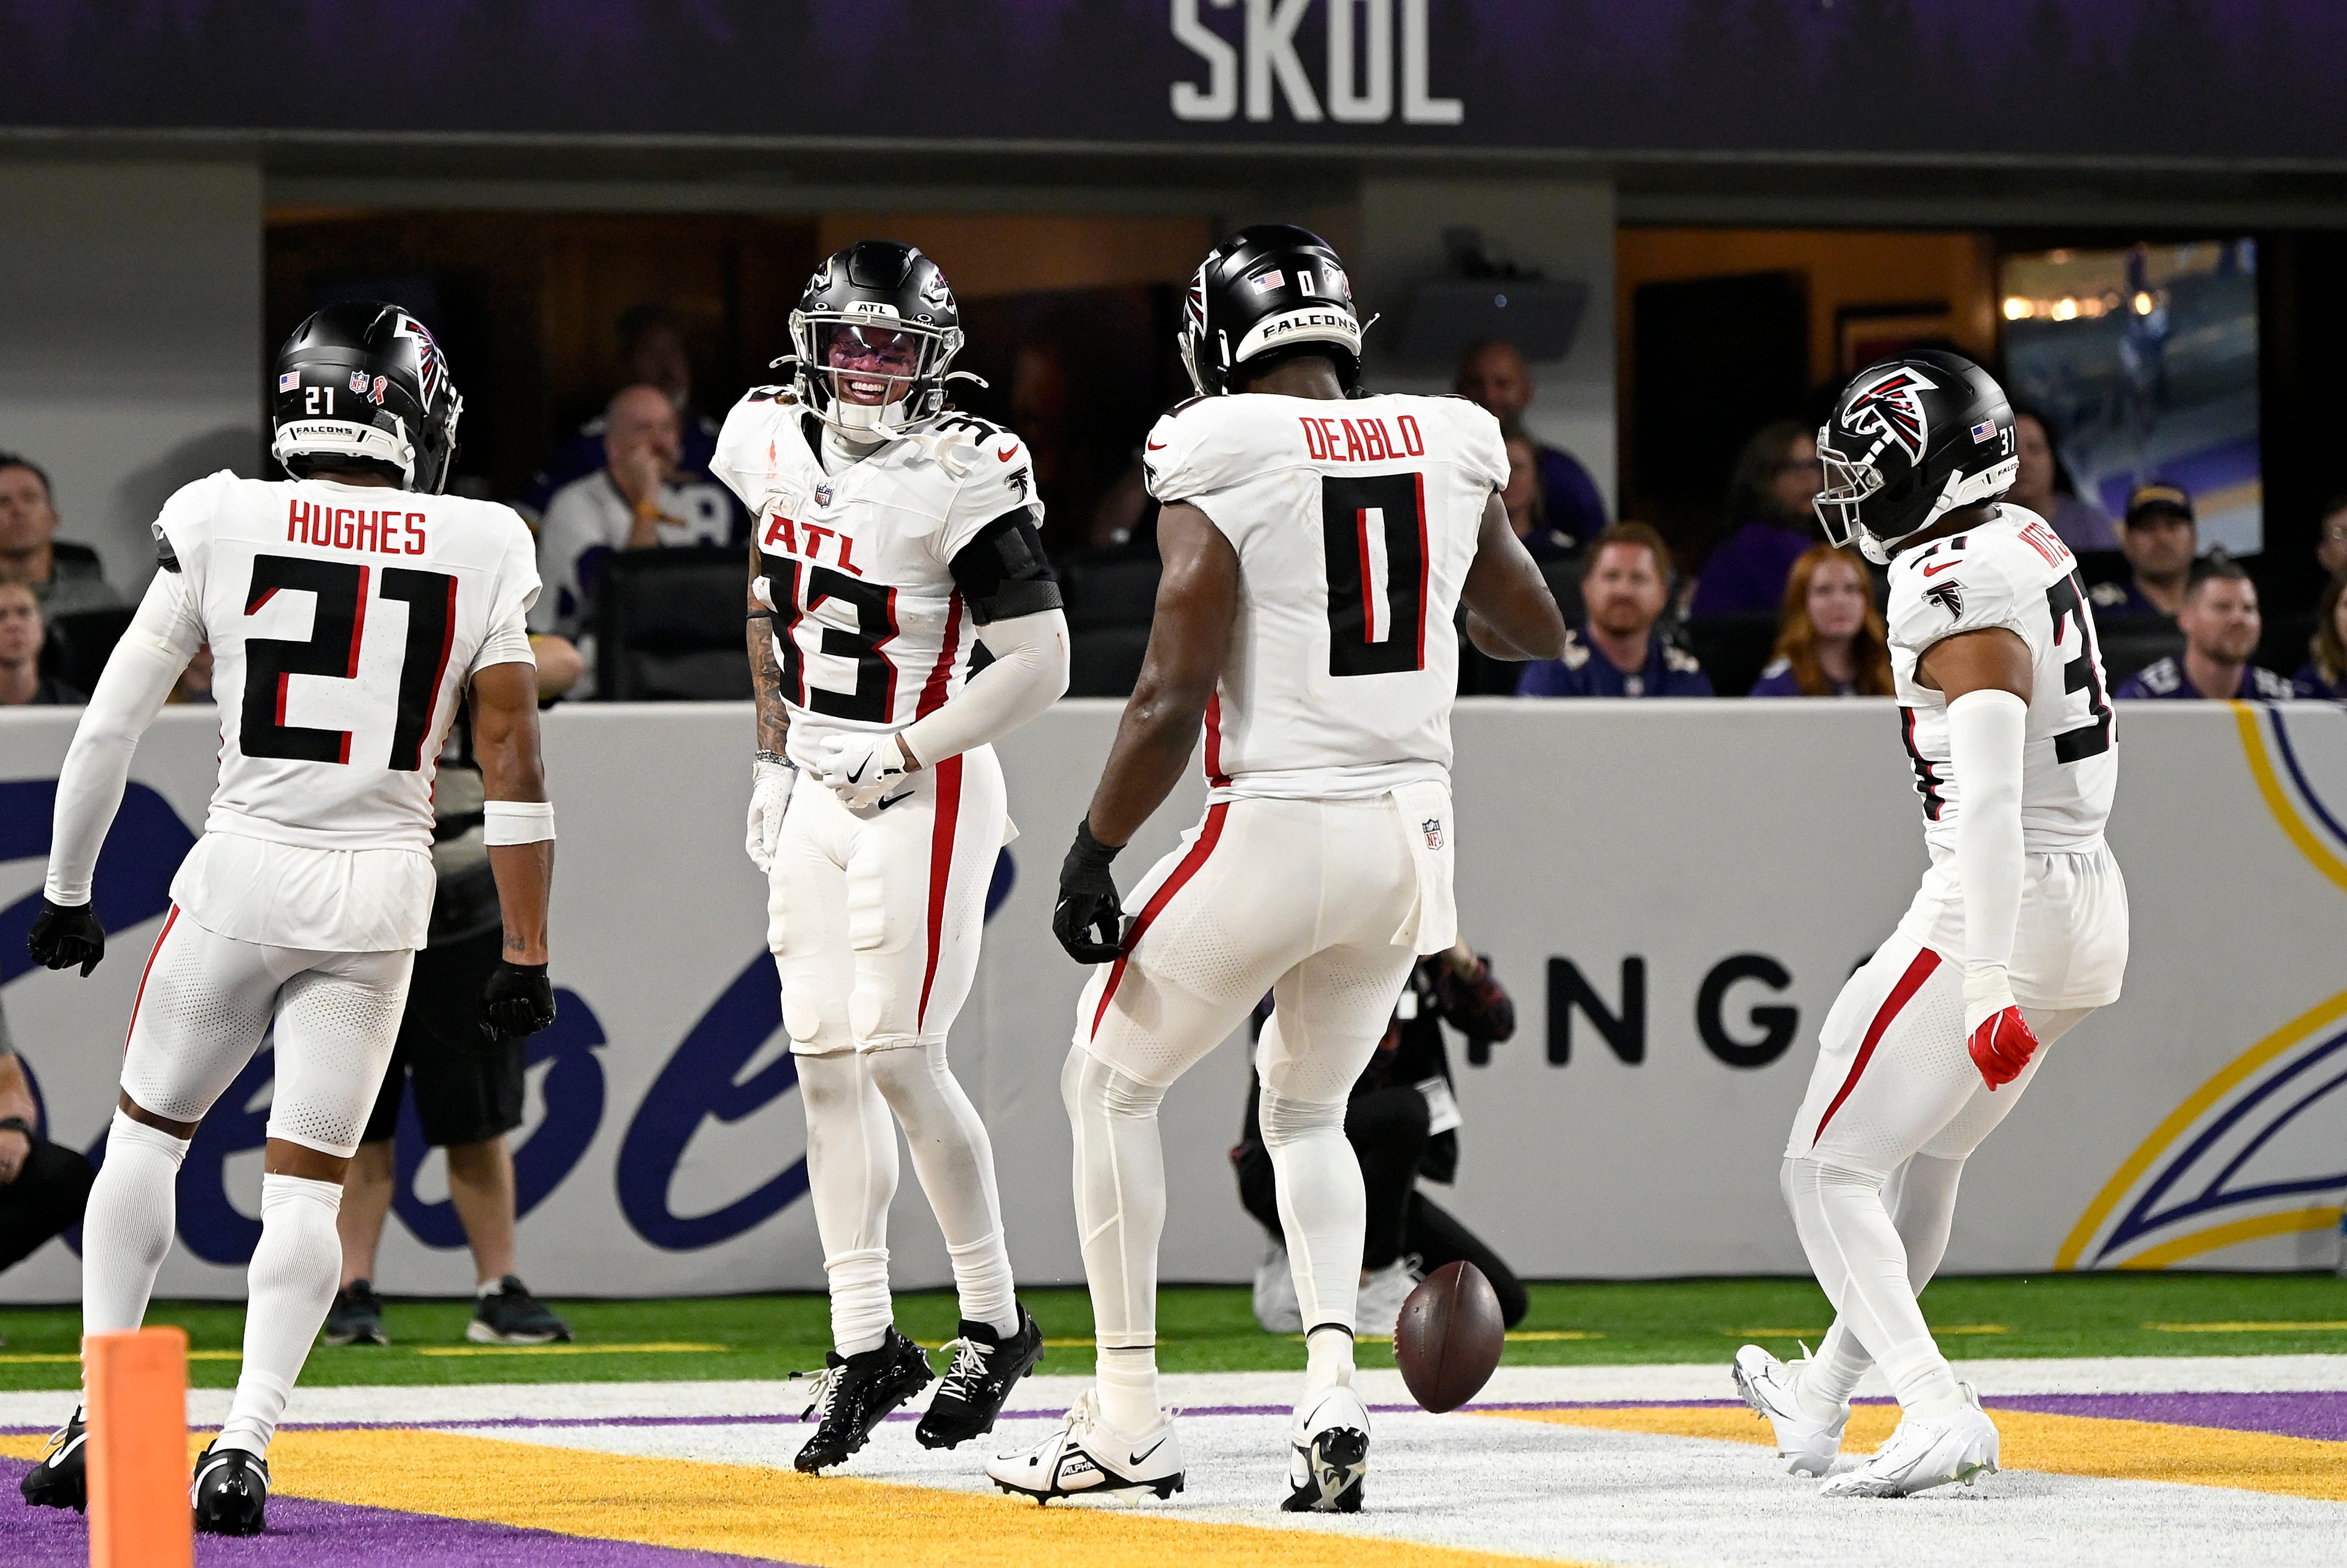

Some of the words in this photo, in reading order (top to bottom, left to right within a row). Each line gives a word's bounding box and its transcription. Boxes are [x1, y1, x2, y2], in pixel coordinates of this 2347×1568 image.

[1169, 0, 1464, 124] SKOL
[1297, 270, 1316, 296] 0
[858, 304, 886, 314] ATL
[1262, 315, 1357, 339] FALCONS
[306, 387, 334, 414] 21
[1299, 415, 1425, 461] DEABLO
[1999, 425, 2014, 456] 31
[287, 499, 426, 555] HUGHES
[764, 513, 864, 577] ATL
[1322, 472, 1430, 677] 0
[240, 554, 458, 772] 21
[2046, 567, 2119, 765] 3
[1426, 832, 1442, 847] NFL
[1063, 1461, 1096, 1475] ALPHA
